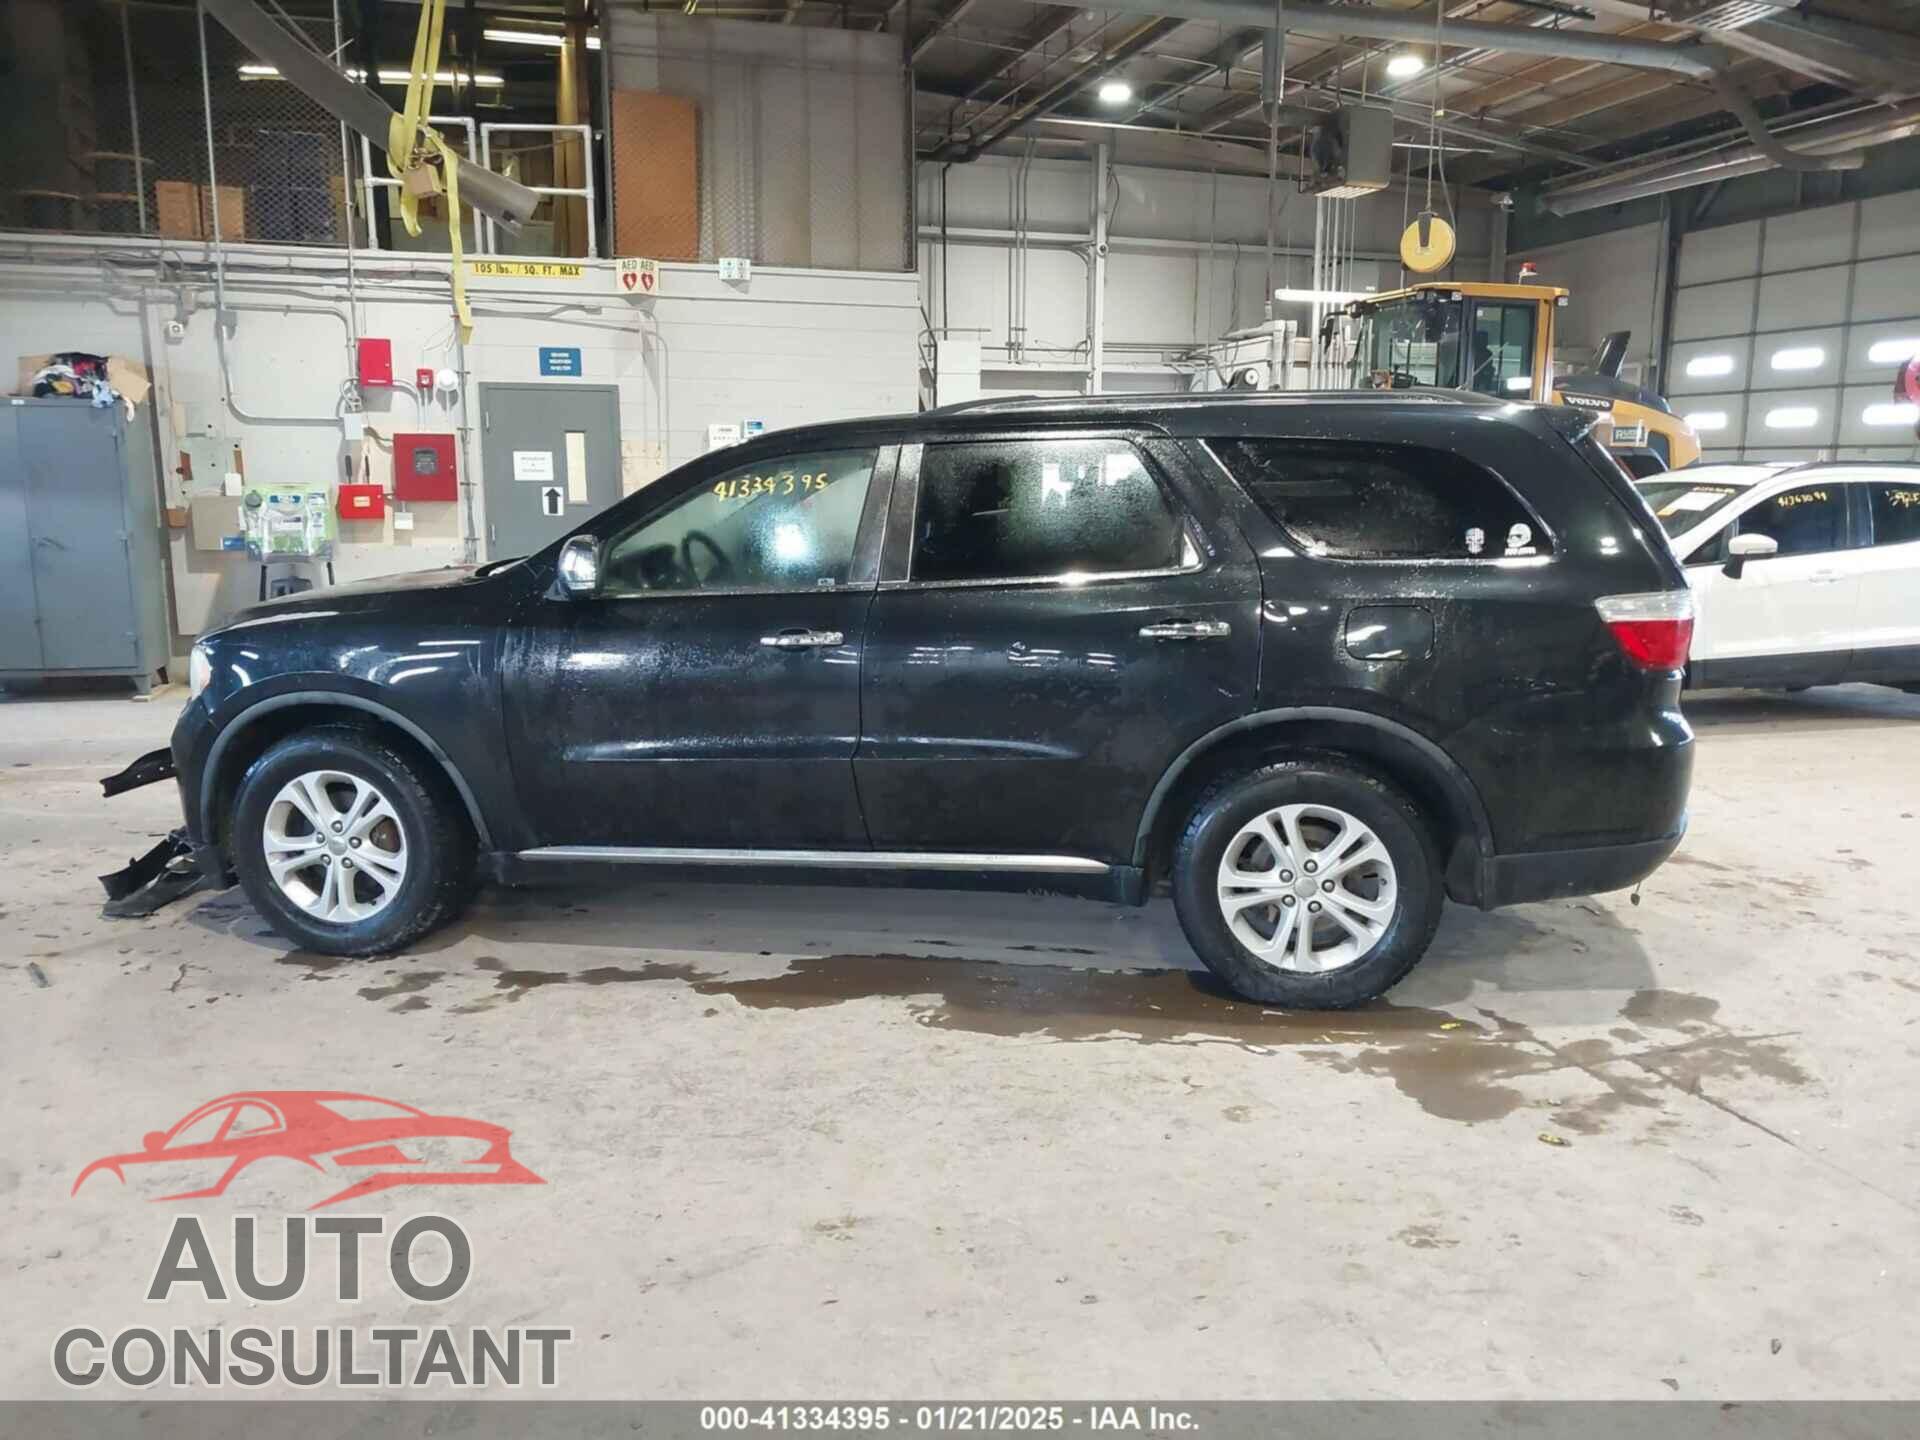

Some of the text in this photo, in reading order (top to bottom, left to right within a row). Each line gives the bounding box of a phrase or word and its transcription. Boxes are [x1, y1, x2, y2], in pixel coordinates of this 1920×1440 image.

[475, 263, 493, 274] 105
[559, 265, 581, 276] MAX
[1566, 396, 1611, 409] VOLVO
